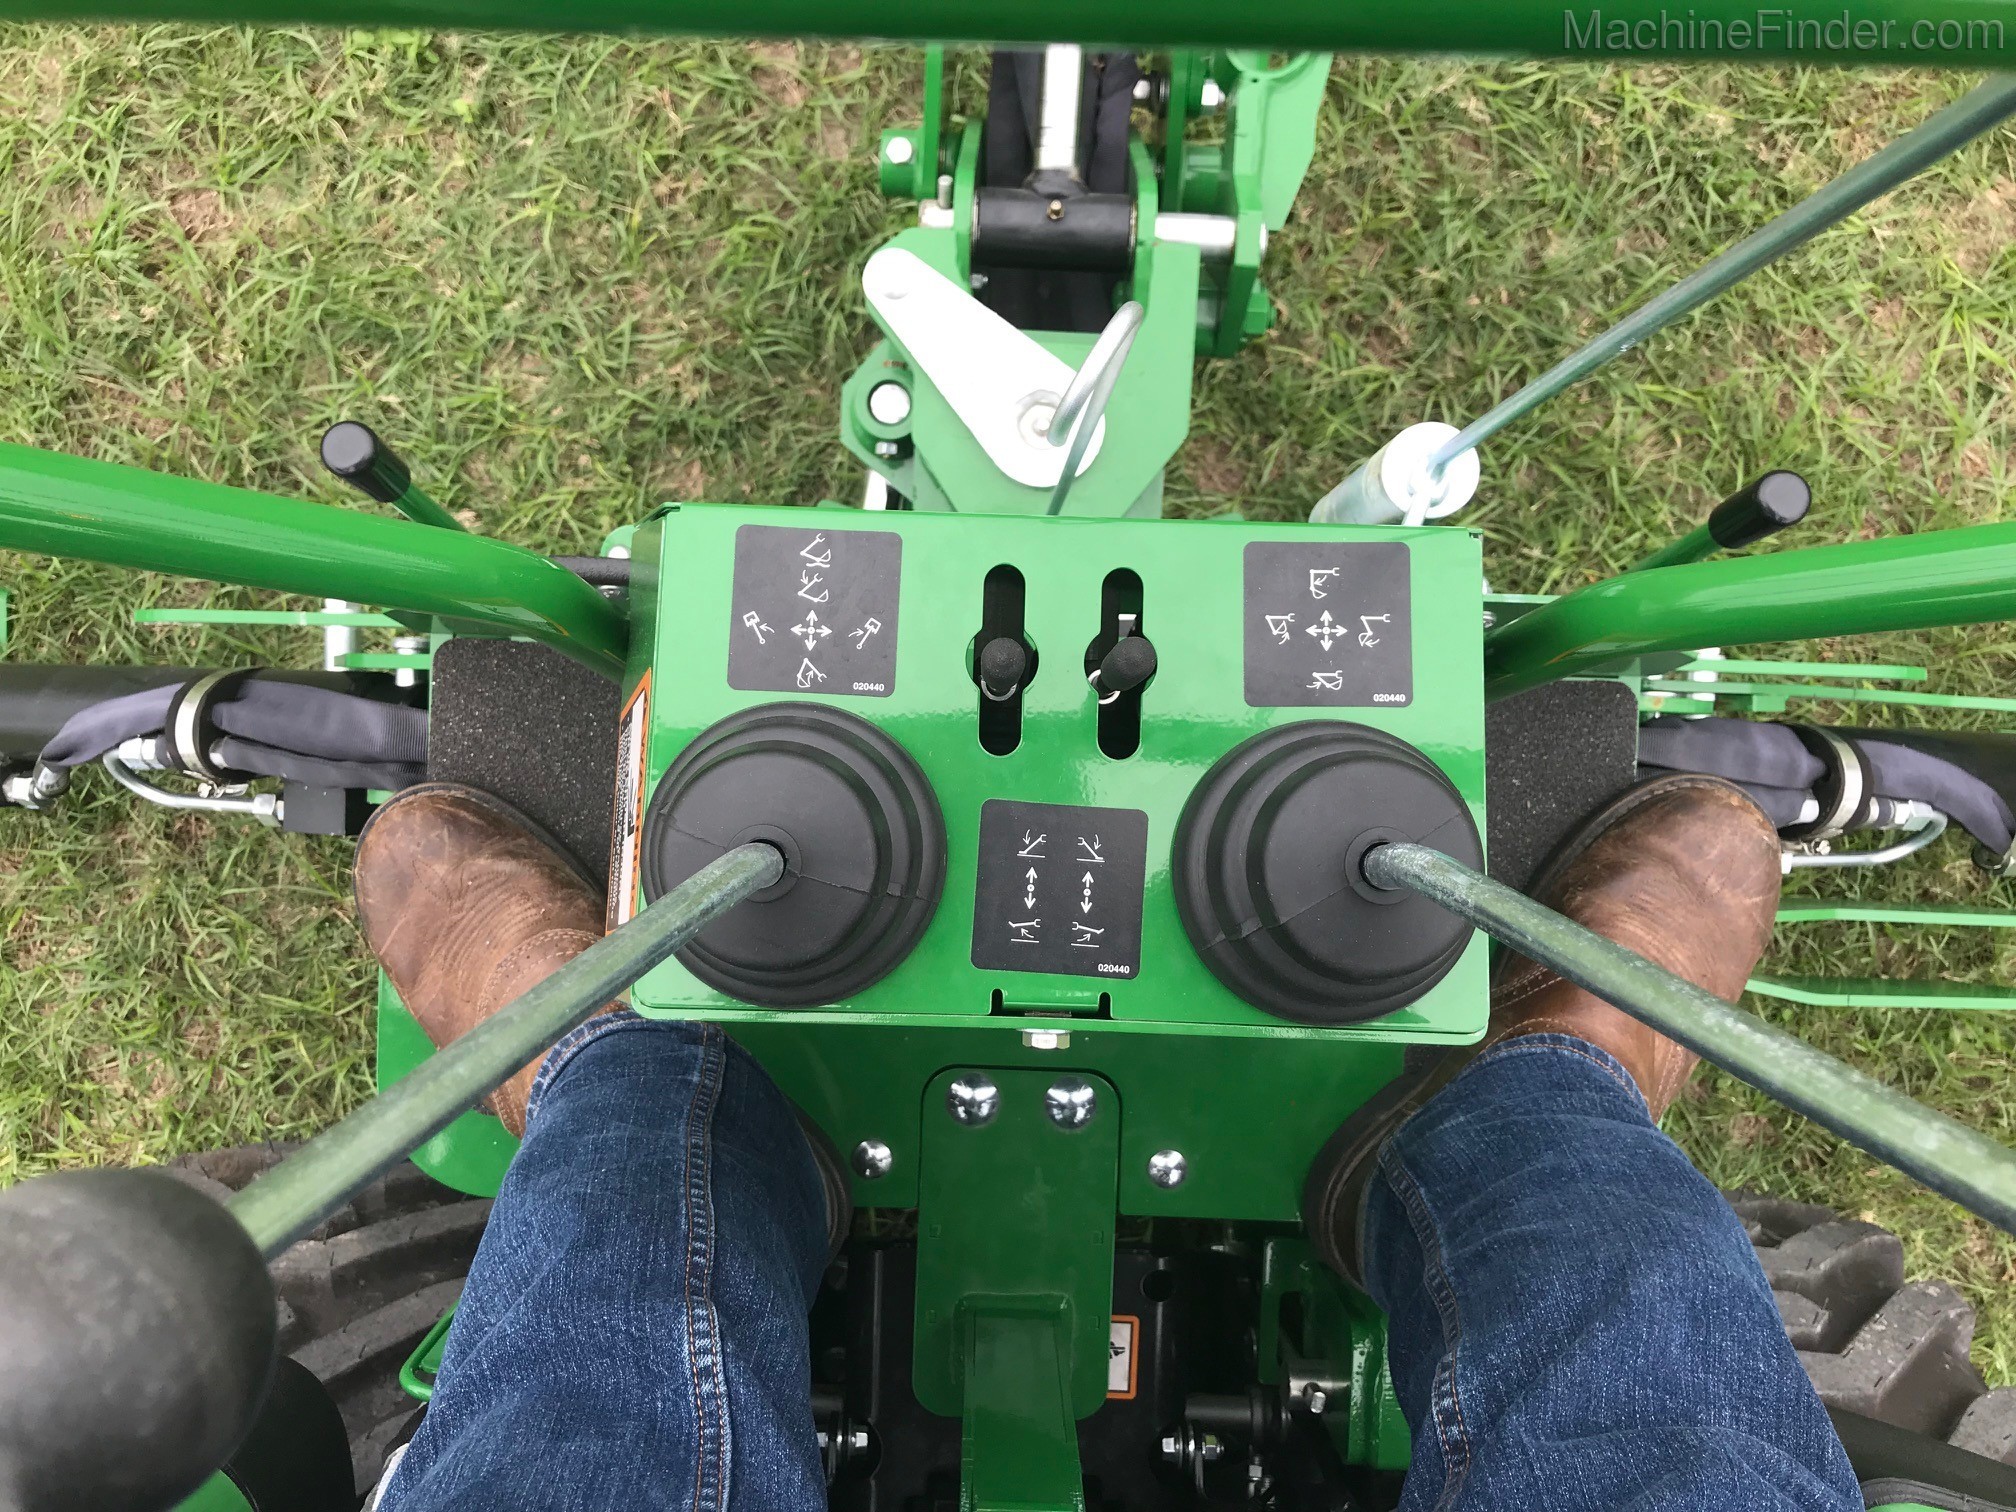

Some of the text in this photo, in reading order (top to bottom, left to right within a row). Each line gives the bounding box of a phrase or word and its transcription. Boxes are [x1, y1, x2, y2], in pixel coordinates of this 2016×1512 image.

[853, 682, 885, 691] 020440
[1373, 693, 1406, 702] 020440
[1098, 963, 1130, 974] 020440
